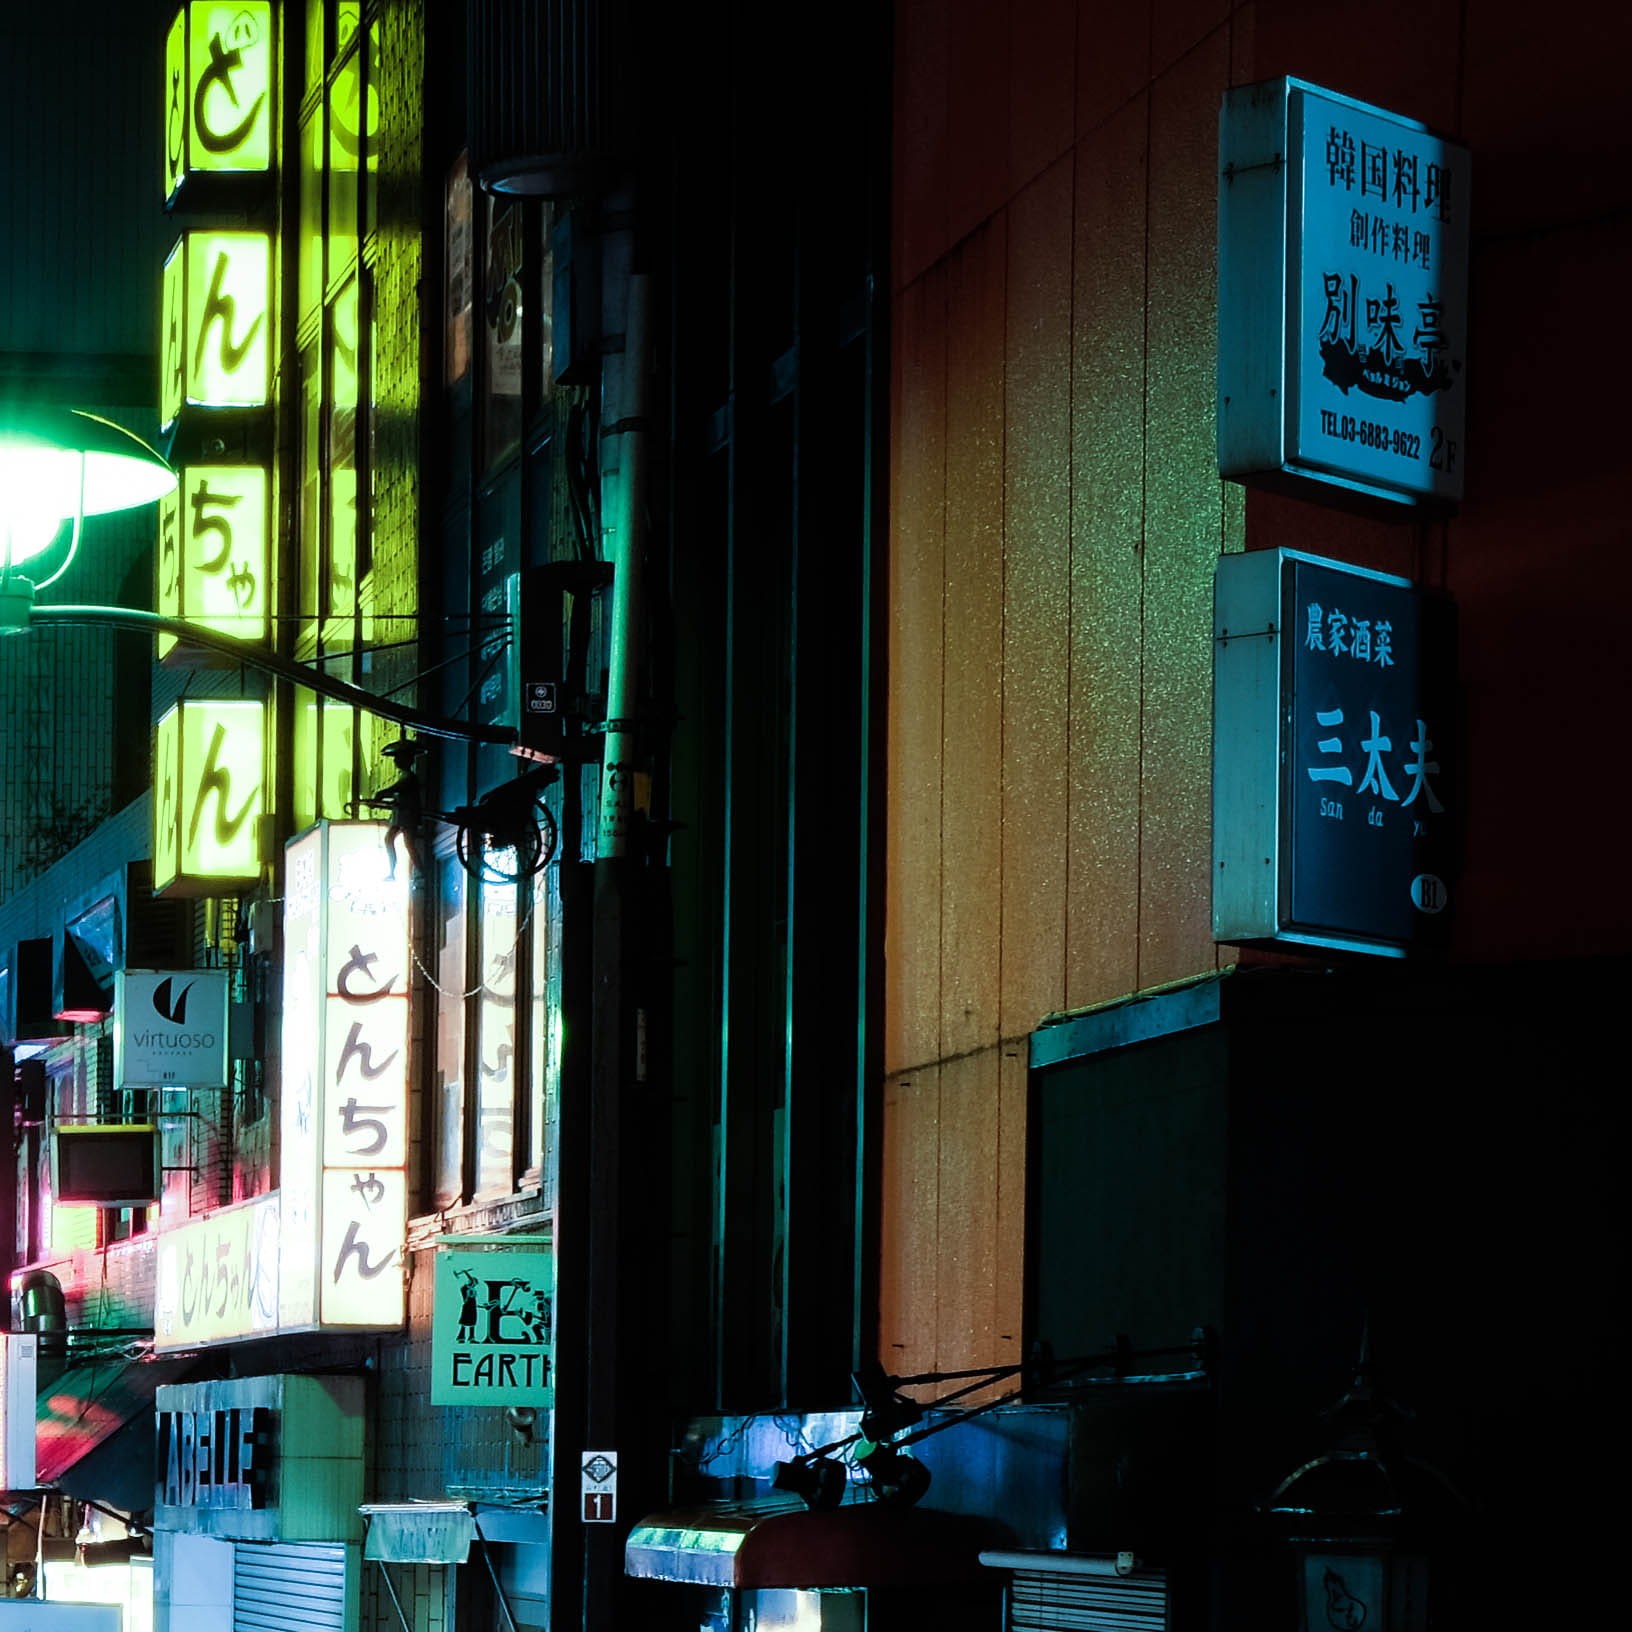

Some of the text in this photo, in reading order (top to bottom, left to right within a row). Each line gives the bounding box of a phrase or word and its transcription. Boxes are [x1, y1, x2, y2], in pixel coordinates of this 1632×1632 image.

[1325, 127, 1452, 224] 韓国料理
[1350, 208, 1430, 270] 創作料理
[1320, 273, 1447, 376] 別味亭
[189, 29, 267, 855] とんちゃん
[1320, 410, 1456, 472] TEL.03-6883-9622 2F
[1305, 602, 1395, 669] 農家酒菜
[1308, 708, 1445, 814] 三太夫
[1320, 797, 1343, 820] San
[1368, 806, 1383, 827] da
[1419, 879, 1439, 909] B1
[134, 1030, 215, 1048] virtuoso
[335, 944, 399, 1287] とんちゃん
[593, 1495, 601, 1519] 1
